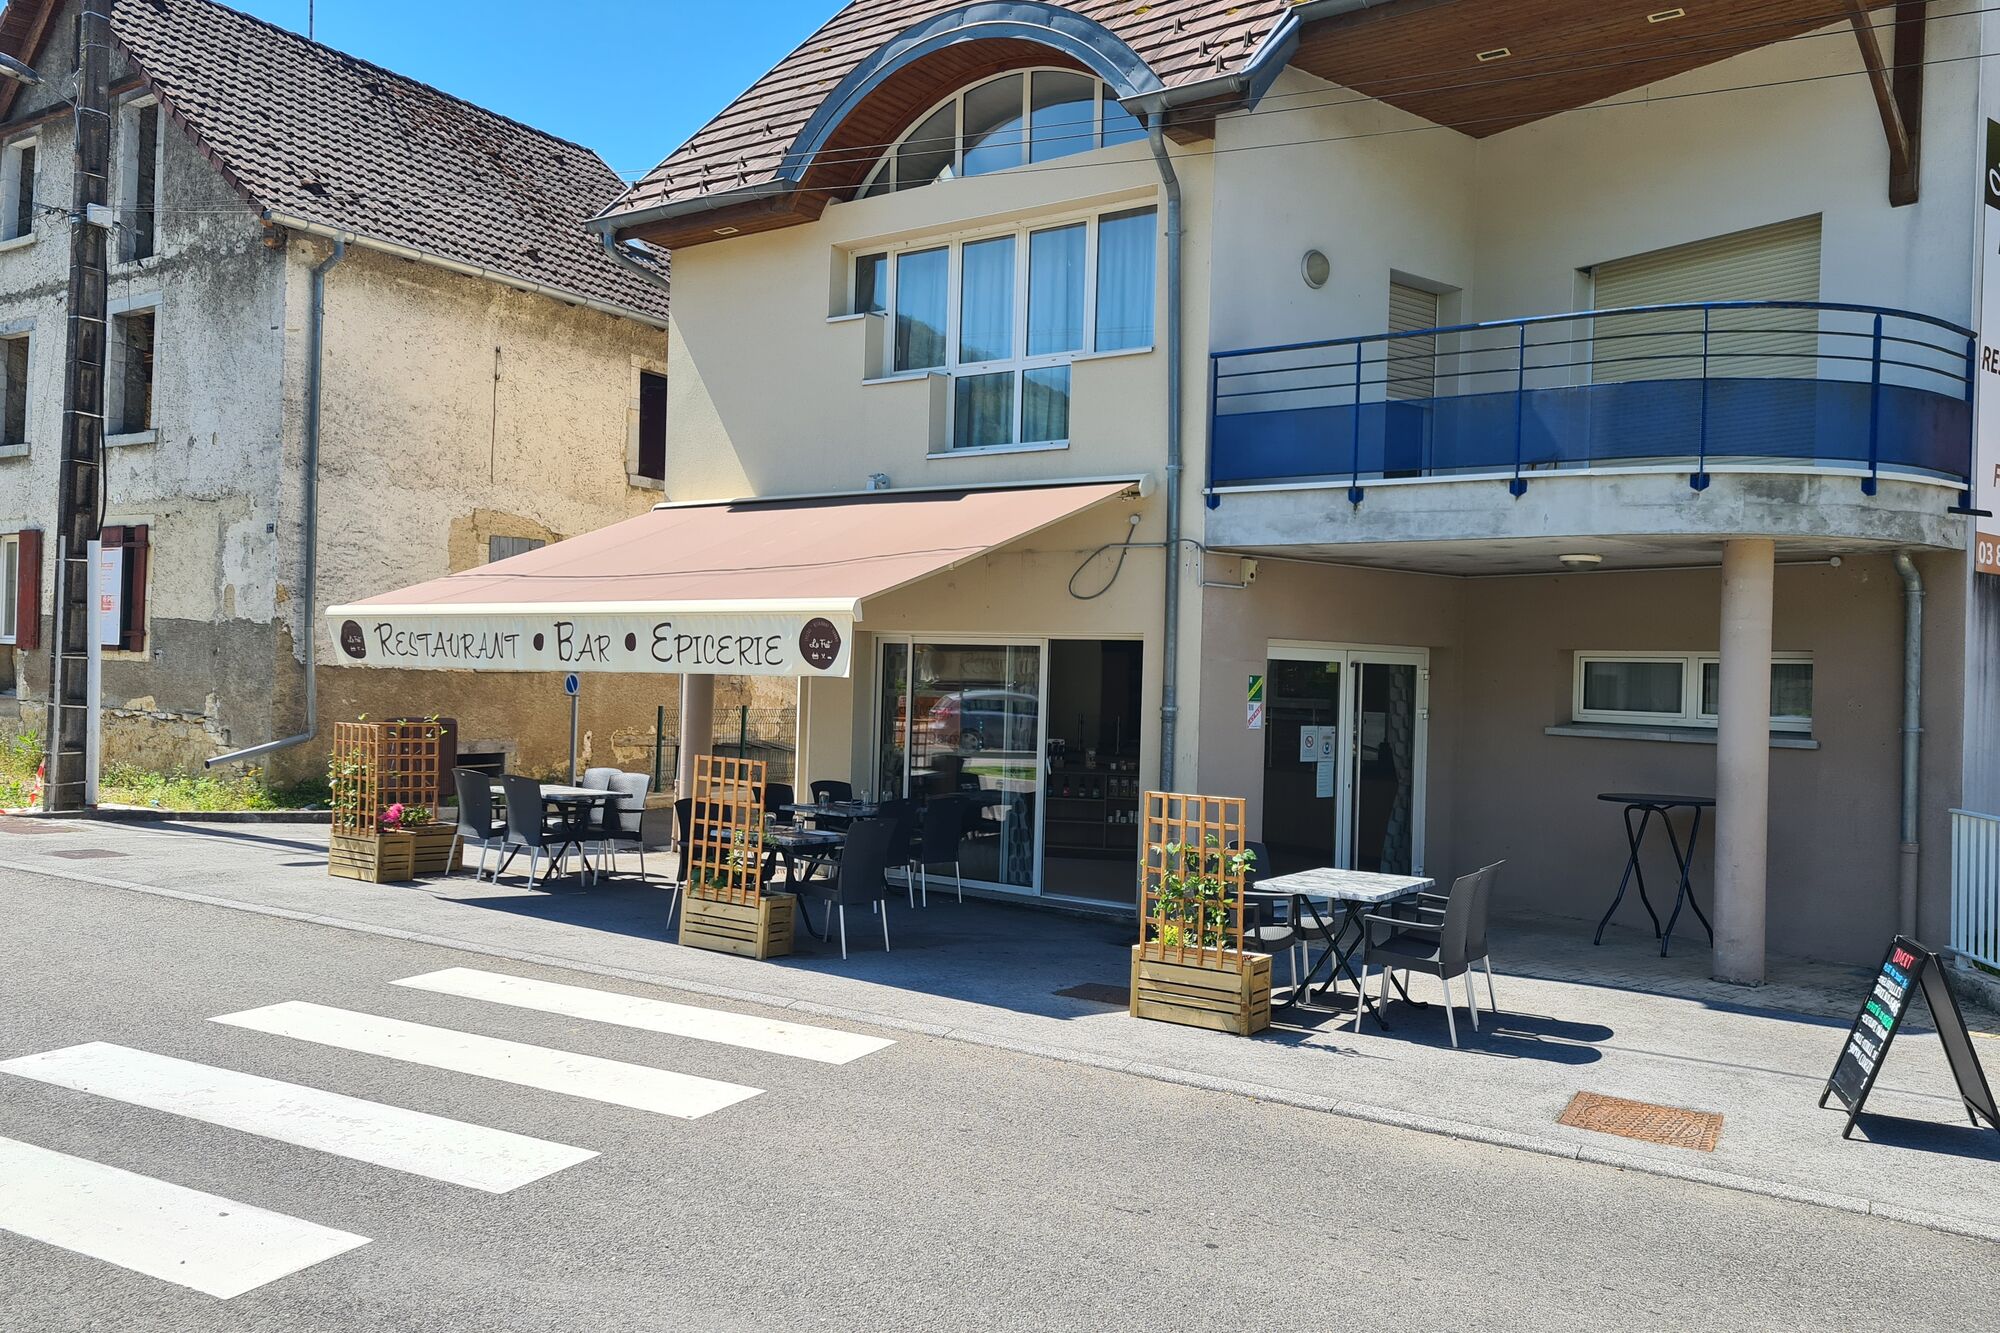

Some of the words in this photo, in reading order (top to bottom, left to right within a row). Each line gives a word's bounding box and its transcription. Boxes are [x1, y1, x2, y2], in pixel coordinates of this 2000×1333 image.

[1979, 540, 1993, 565] 03
[374, 622, 520, 660] RESTAURANT
[554, 621, 611, 662] BAR
[651, 622, 784, 666] EPICERIE
